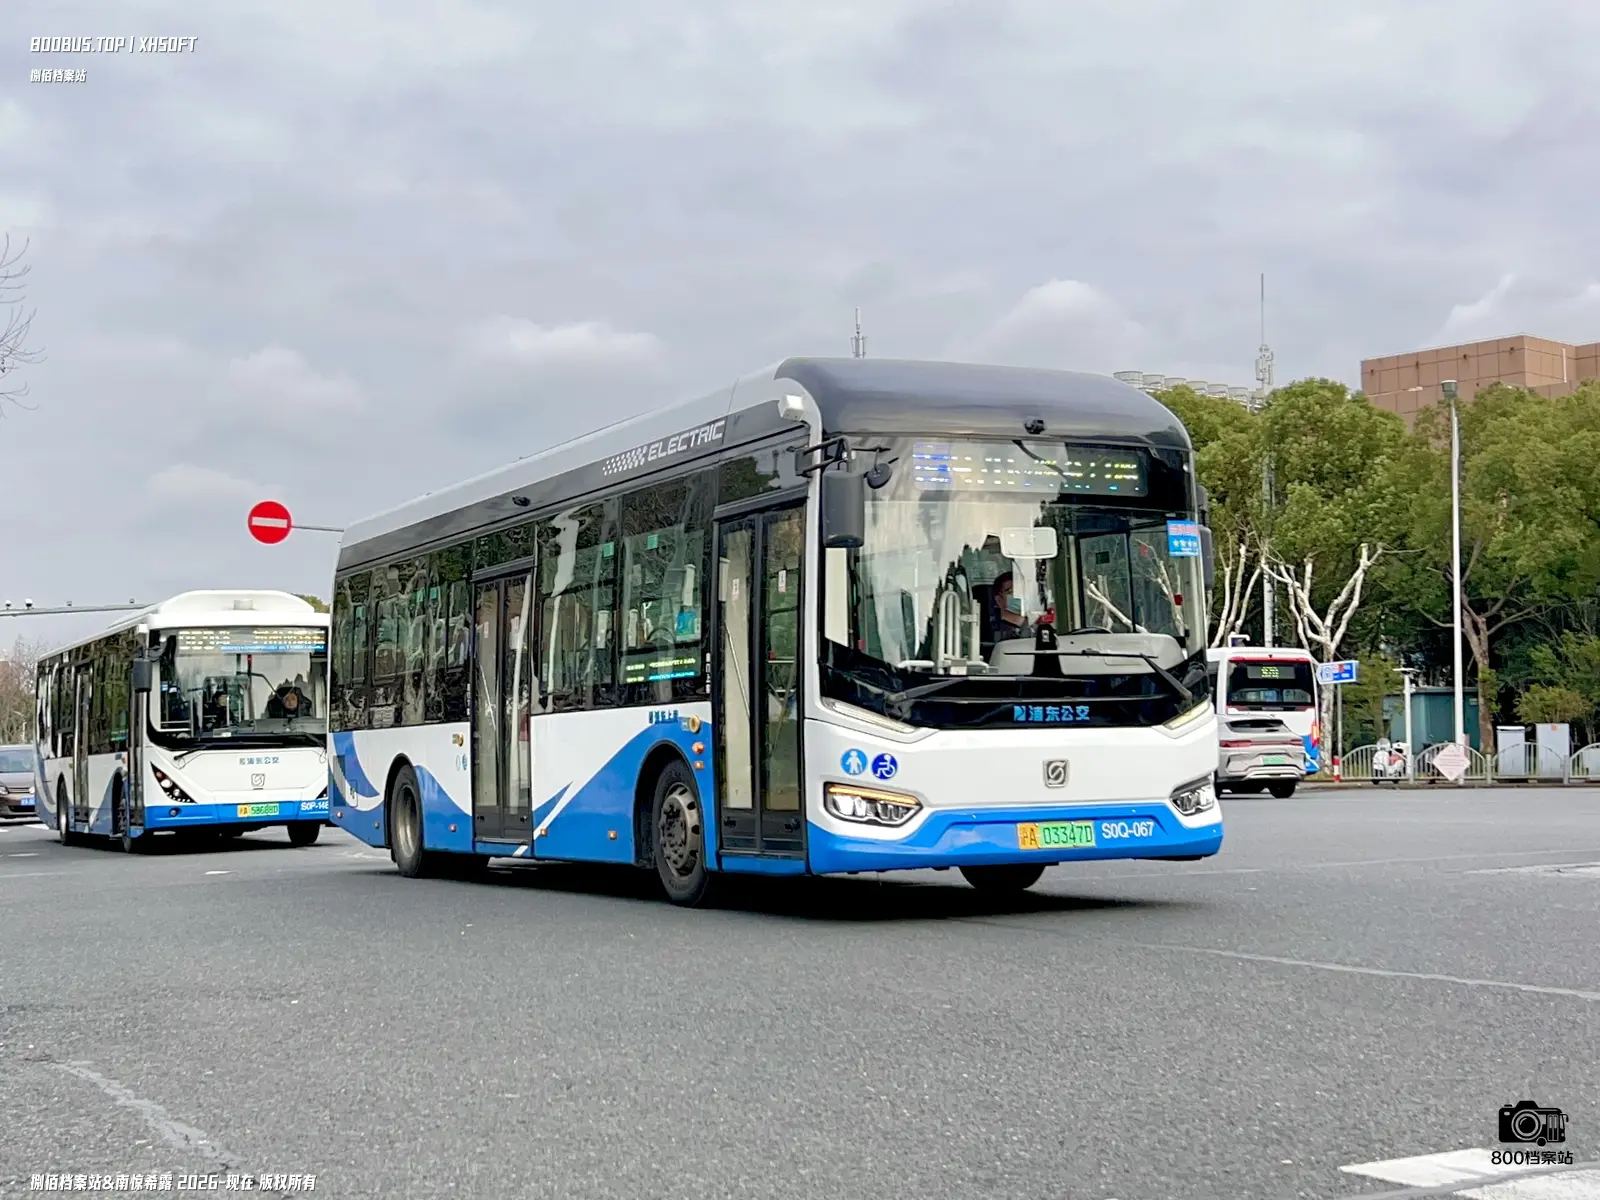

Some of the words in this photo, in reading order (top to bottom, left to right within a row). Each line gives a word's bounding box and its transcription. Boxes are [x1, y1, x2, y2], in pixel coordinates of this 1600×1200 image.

[647, 420, 726, 462] ELECTRIC
[1028, 704, 1090, 721] 浦东公交
